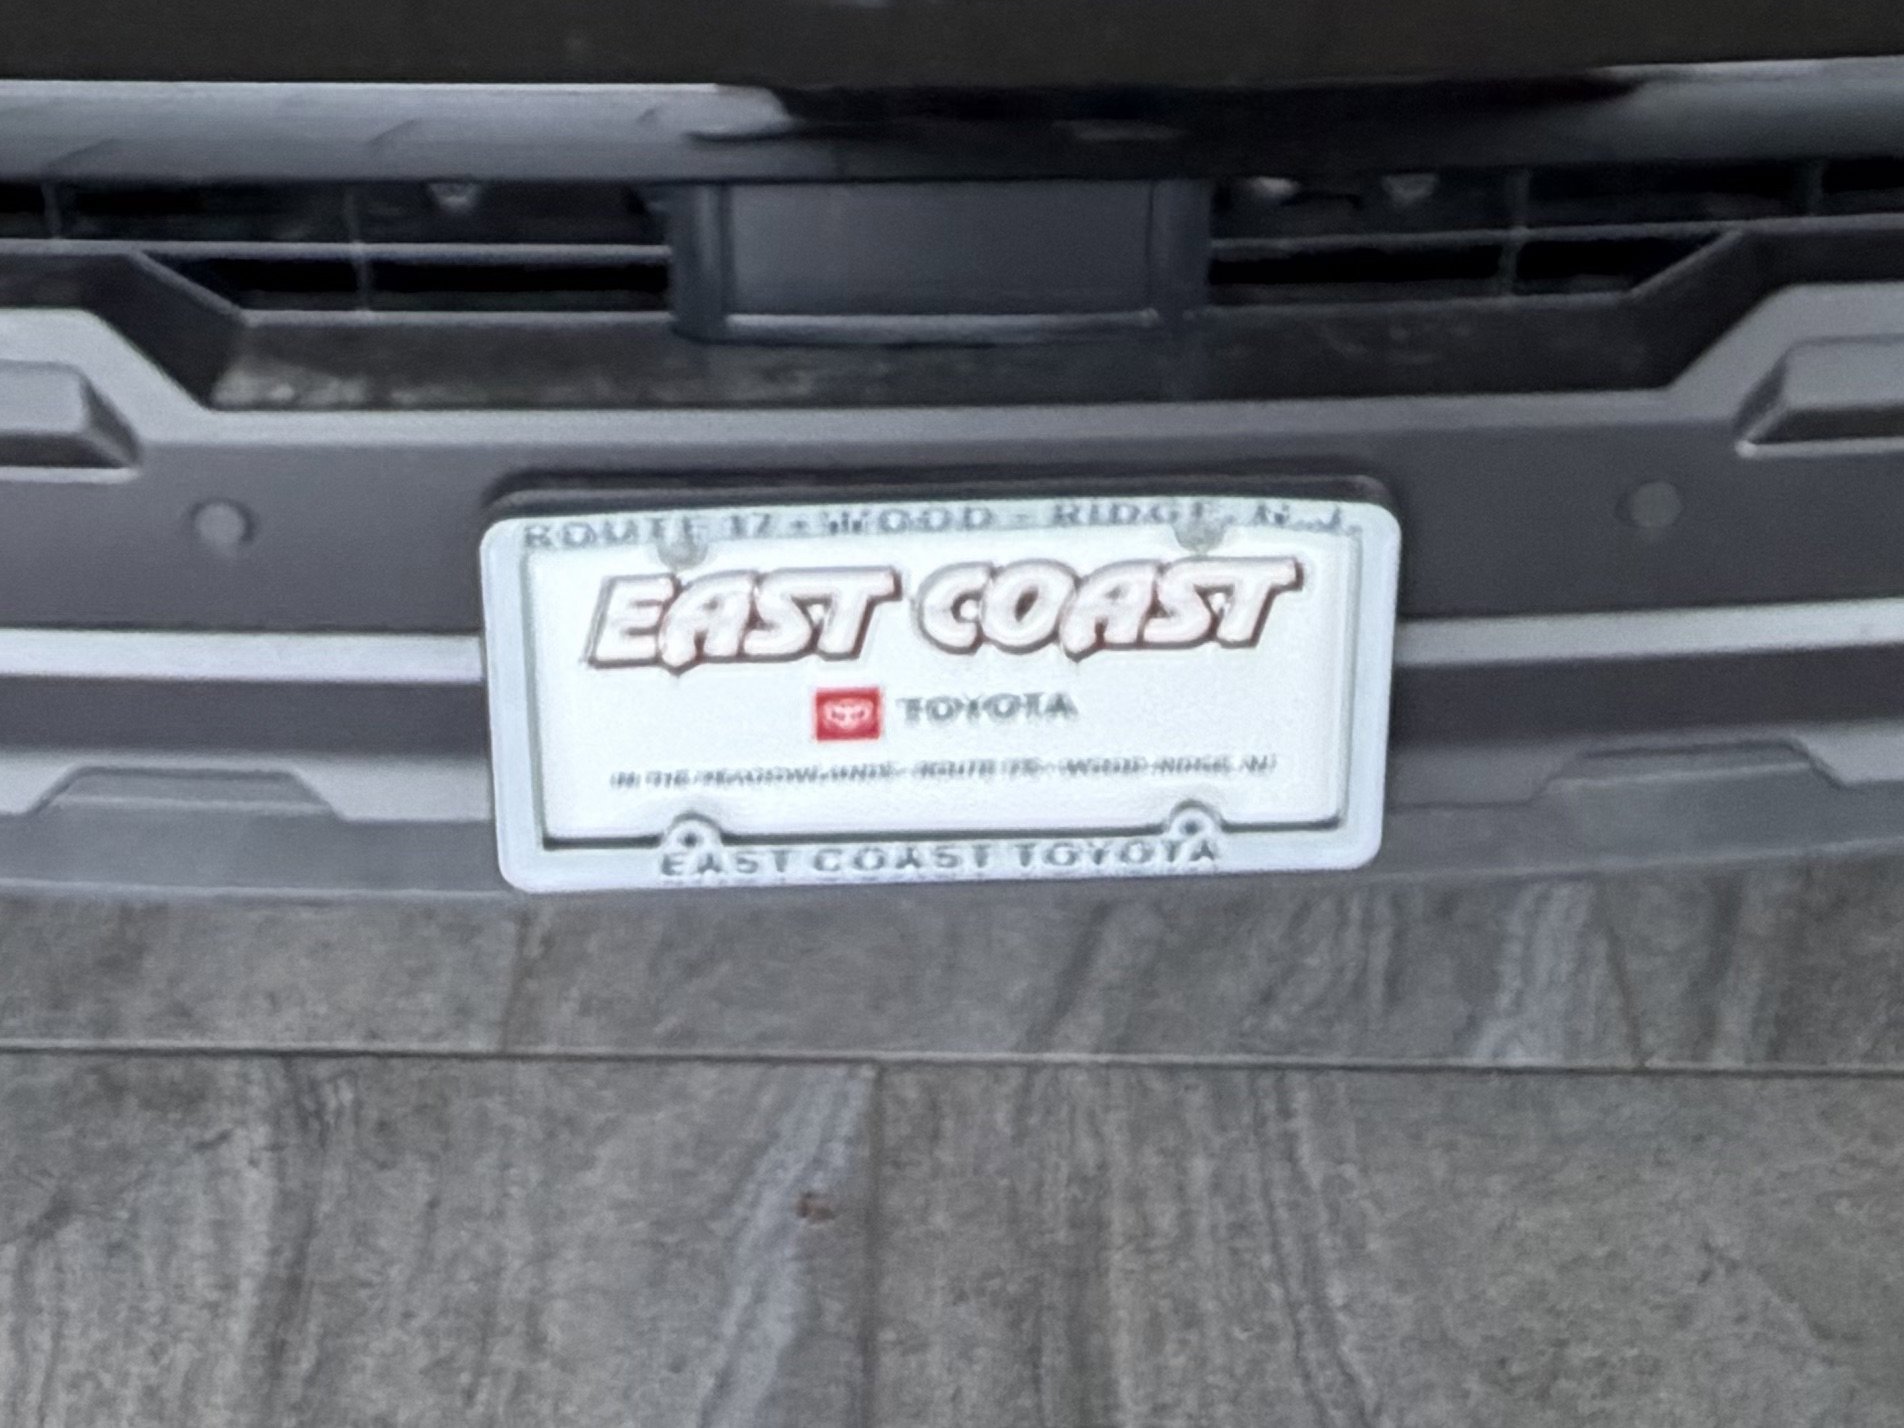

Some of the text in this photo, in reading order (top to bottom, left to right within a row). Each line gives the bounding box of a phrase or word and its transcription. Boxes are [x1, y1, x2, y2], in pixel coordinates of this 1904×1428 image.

[524, 516, 700, 548] ROUTE
[728, 513, 774, 538] 17
[825, 507, 995, 537] WOOD
[582, 555, 1305, 678] EAST COAST
[897, 692, 1080, 724] TOYOTA
[661, 840, 1219, 877] EAST COAST TOYOTA
